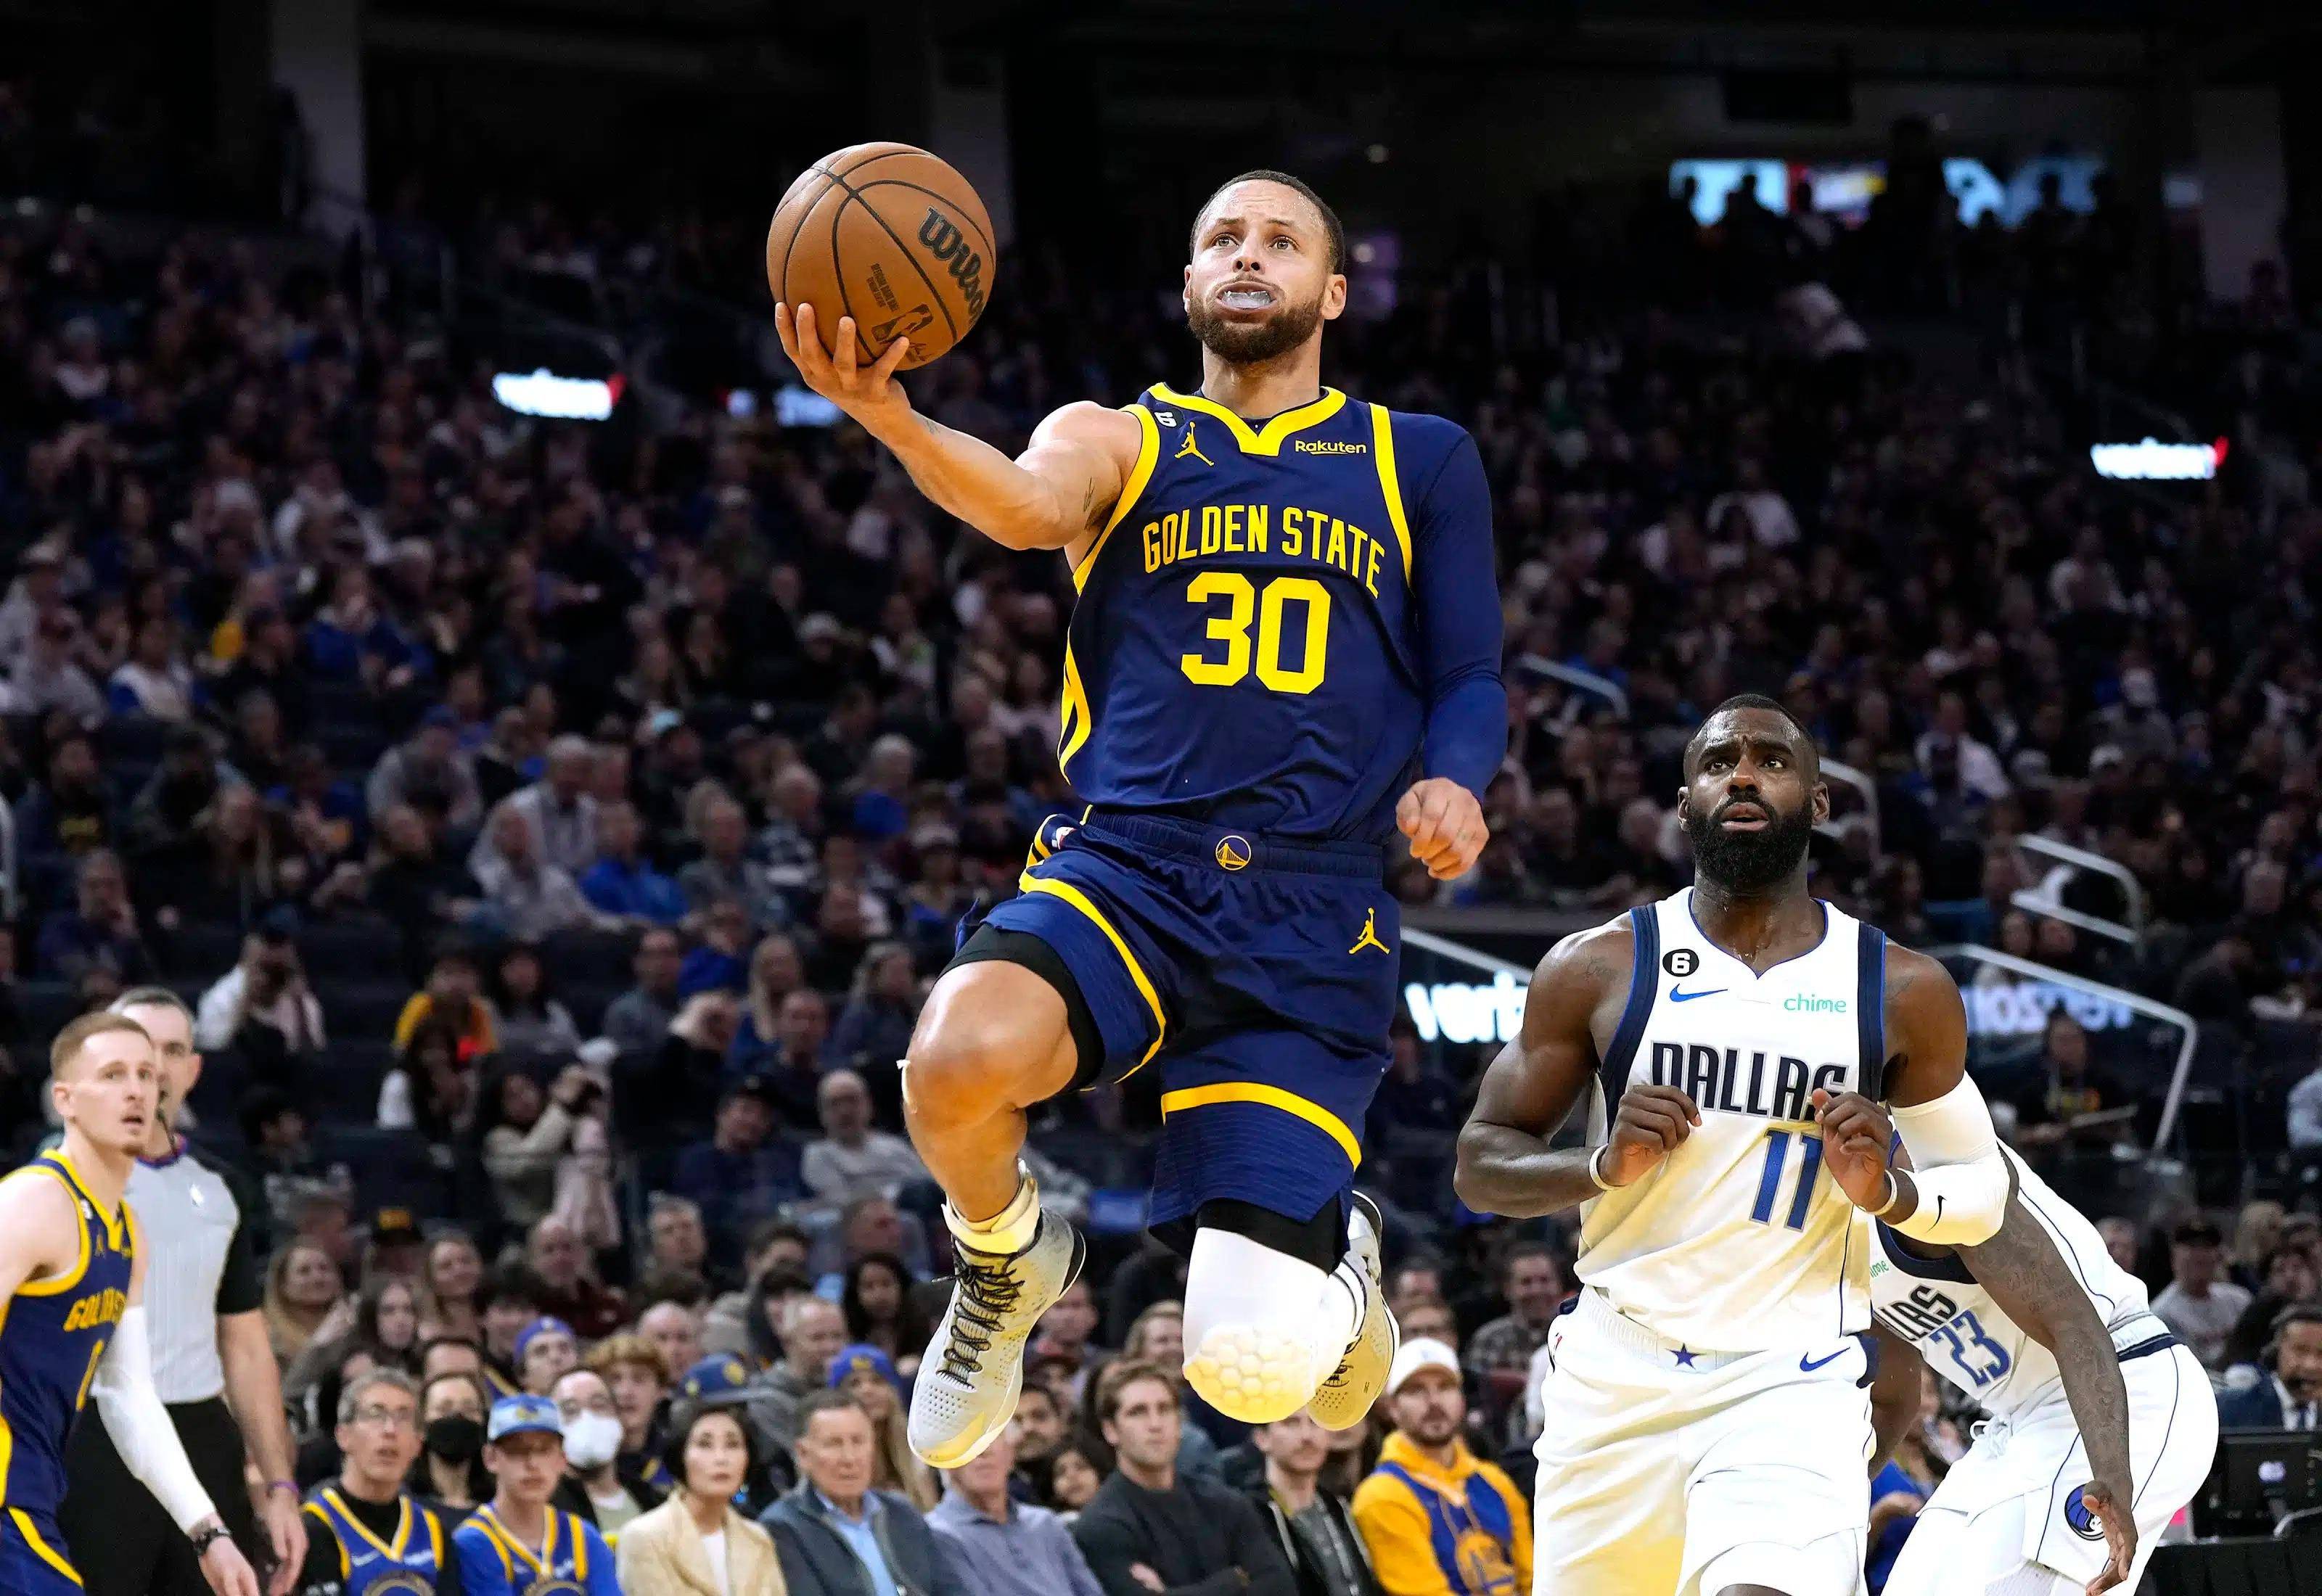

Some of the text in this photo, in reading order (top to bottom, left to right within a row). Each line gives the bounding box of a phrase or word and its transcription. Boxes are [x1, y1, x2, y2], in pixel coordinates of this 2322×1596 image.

[1295, 439, 1367, 455] Rakuten
[1142, 504, 1387, 599] GOLDEN STATE
[1181, 572, 1332, 695] 30
[1670, 951, 1691, 975] 6
[1783, 992, 1847, 1013] chime
[1749, 1127, 1825, 1233] 11
[1870, 1260, 1890, 1278] ime
[1871, 1283, 1959, 1342] LLAS
[1927, 1309, 2011, 1388] 23
